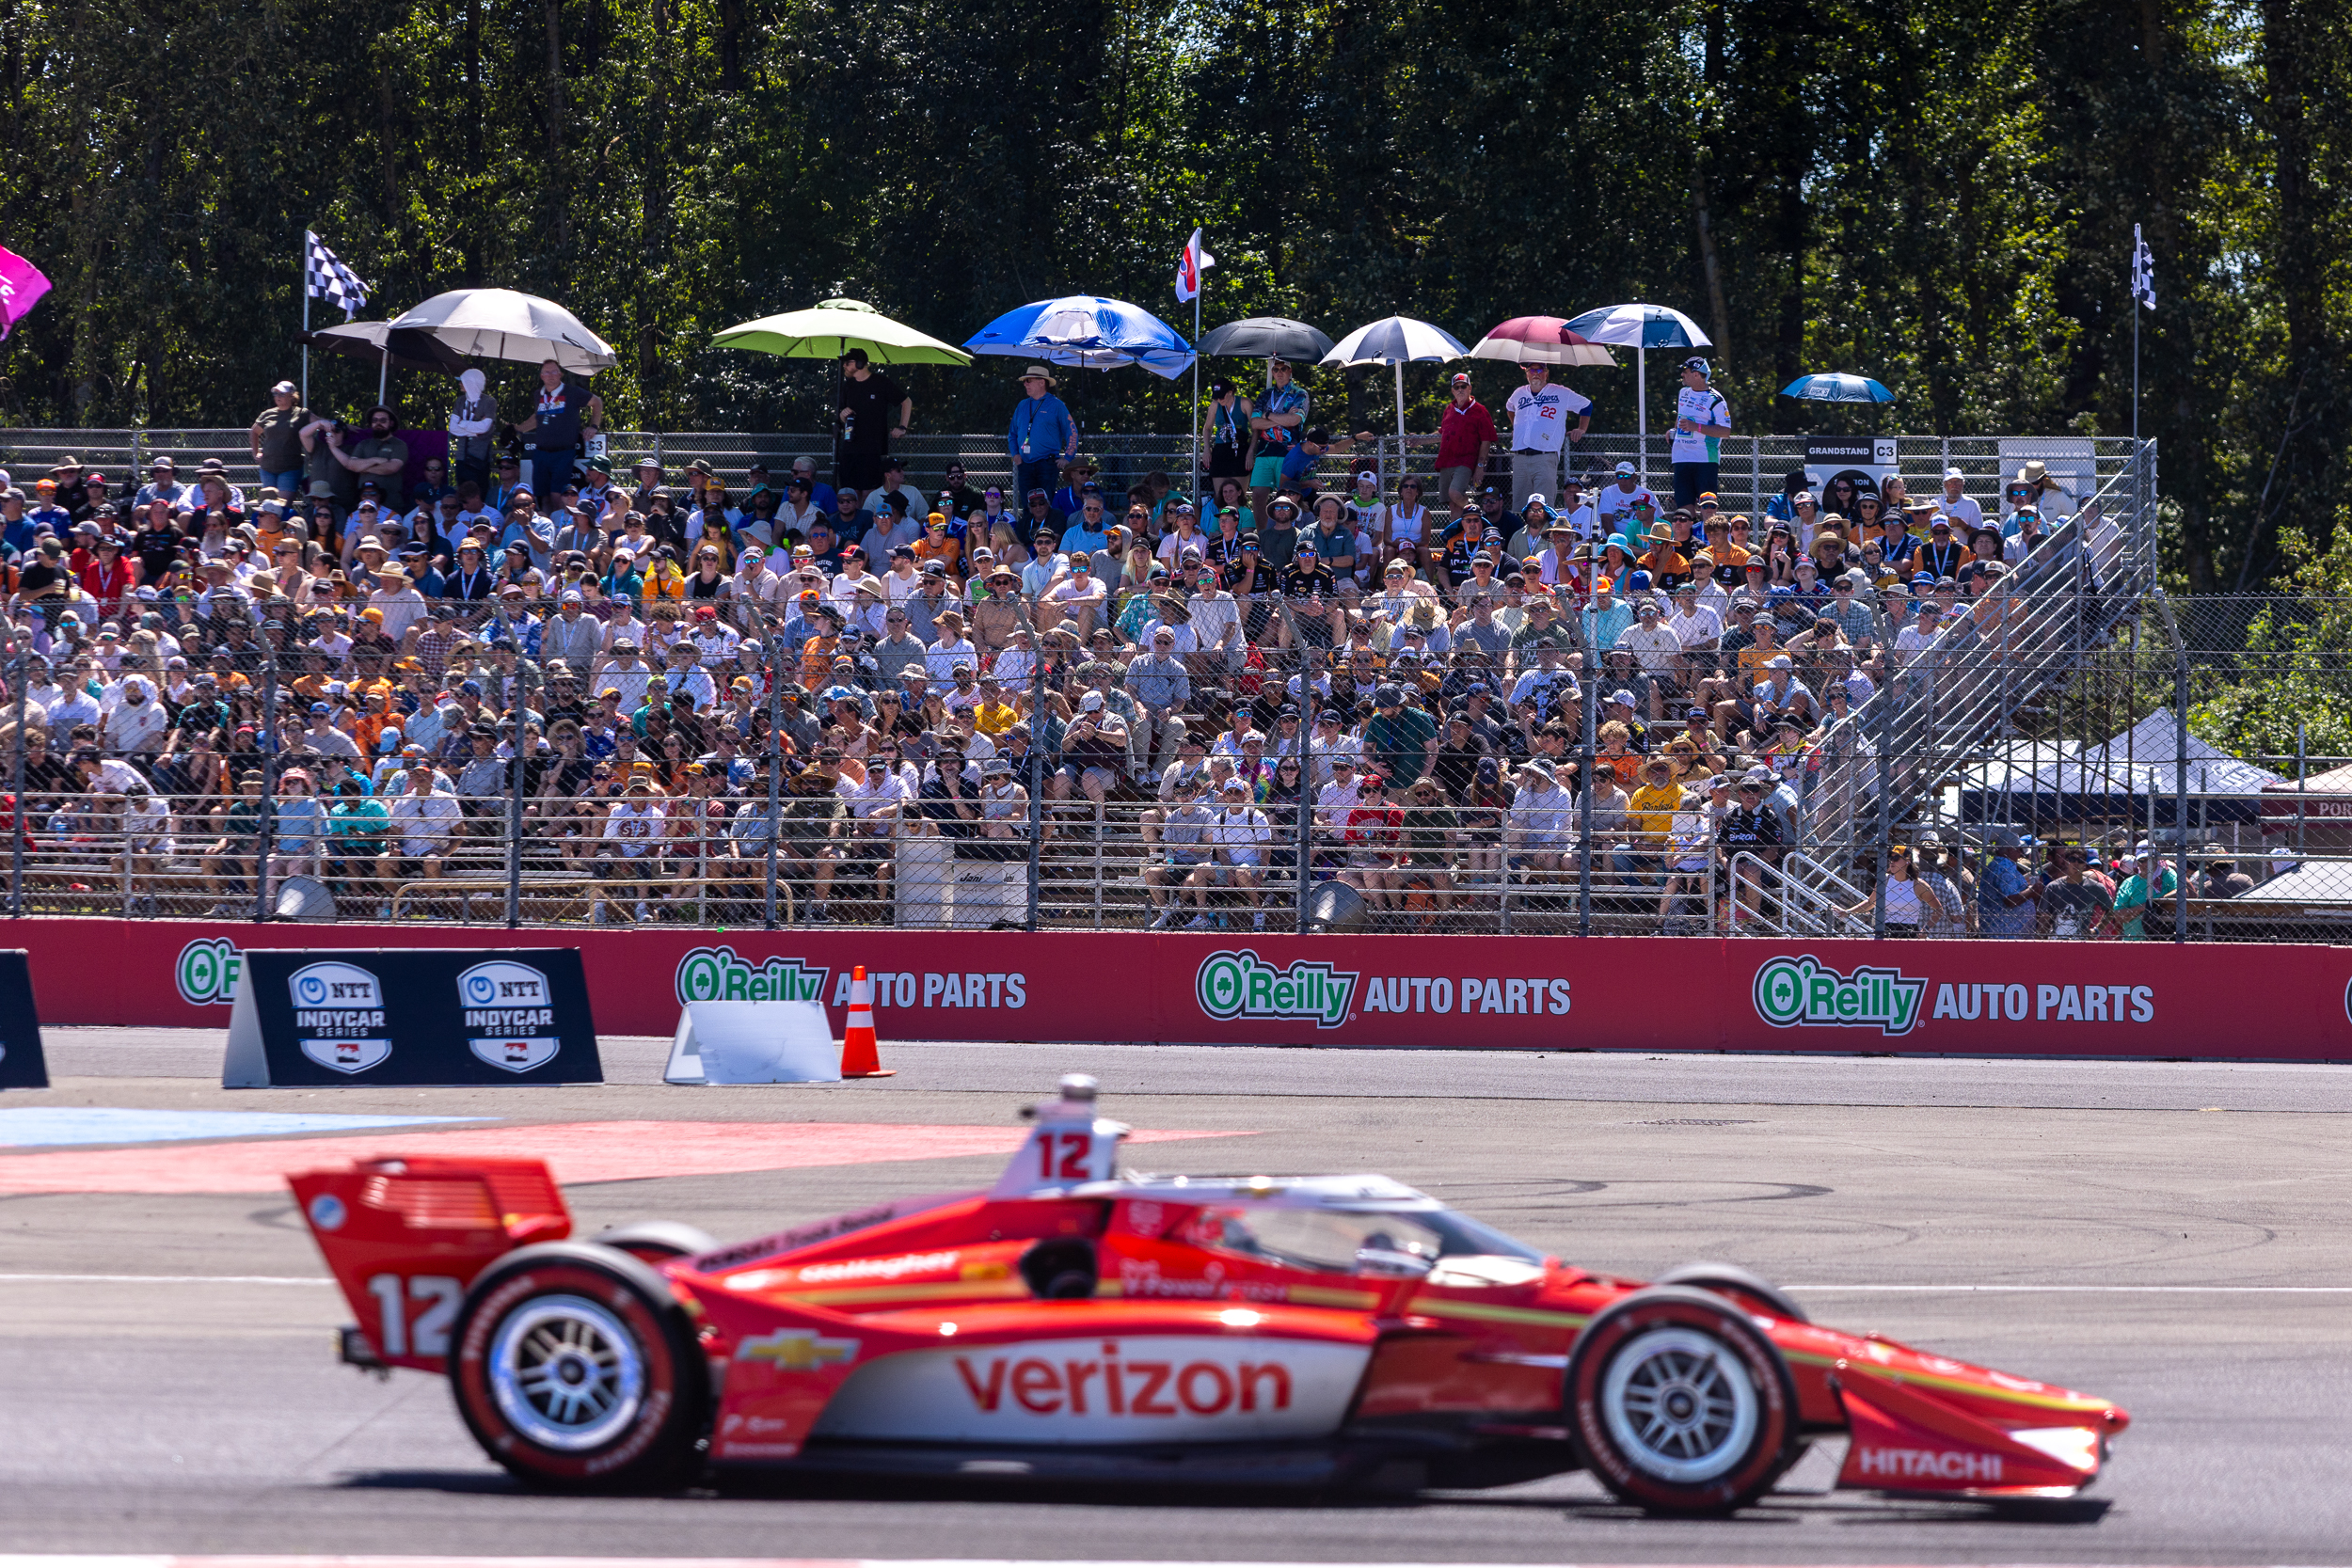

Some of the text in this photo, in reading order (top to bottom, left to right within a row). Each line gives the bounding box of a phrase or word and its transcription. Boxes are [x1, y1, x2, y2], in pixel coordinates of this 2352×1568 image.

[1518, 393, 1560, 408] Dodgers
[1540, 405, 1557, 420] 22
[589, 440, 603, 451] C3
[1808, 447, 1869, 455] GRANDSTAND
[1876, 446, 1894, 457] C3
[499, 981, 540, 997] NTT
[684, 955, 818, 1001] O'Reilly
[923, 973, 1026, 1008] PARTS
[1205, 958, 1571, 1018] O'Reilly AUTO PARTS
[330, 982, 373, 998] NTT
[1762, 964, 2154, 1025] O'Reilly AUTO PARTS
[296, 1011, 386, 1027] INDYCAR
[465, 1008, 553, 1027] INDYCAR
[316, 1027, 369, 1037] SERIES
[485, 1025, 536, 1037] SERIES
[1037, 1132, 1092, 1180] 12
[367, 1273, 464, 1355] 12
[955, 1340, 1292, 1416] verizon
[1861, 1448, 2002, 1481] HITACHI
